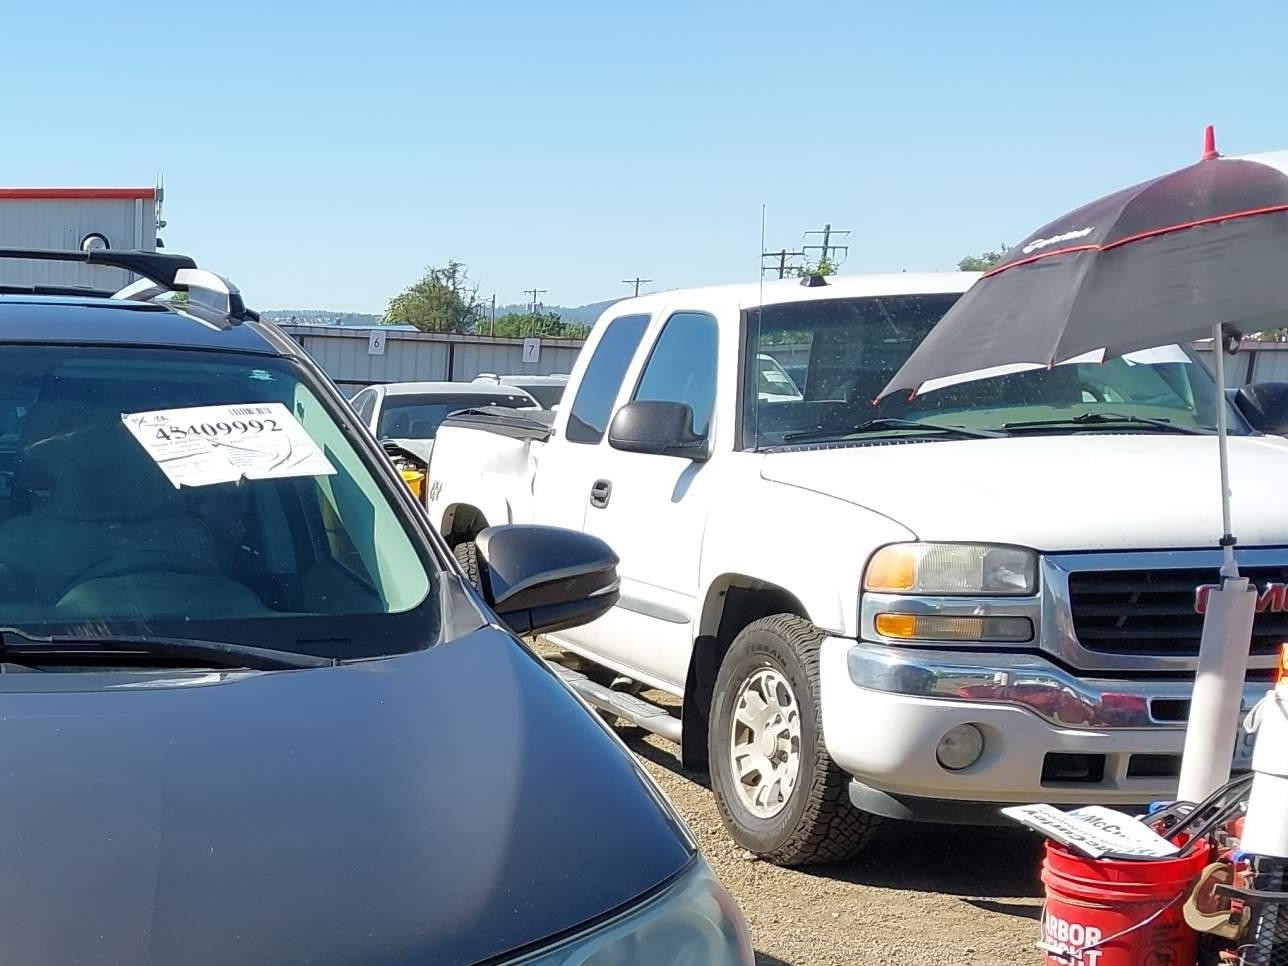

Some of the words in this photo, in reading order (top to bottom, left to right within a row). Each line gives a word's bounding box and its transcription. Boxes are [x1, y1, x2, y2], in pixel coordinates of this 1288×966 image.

[374, 337, 380, 348] 6
[528, 344, 535, 356] 7
[155, 419, 283, 441] 45409992
[1045, 910, 1103, 948] ARBOR
